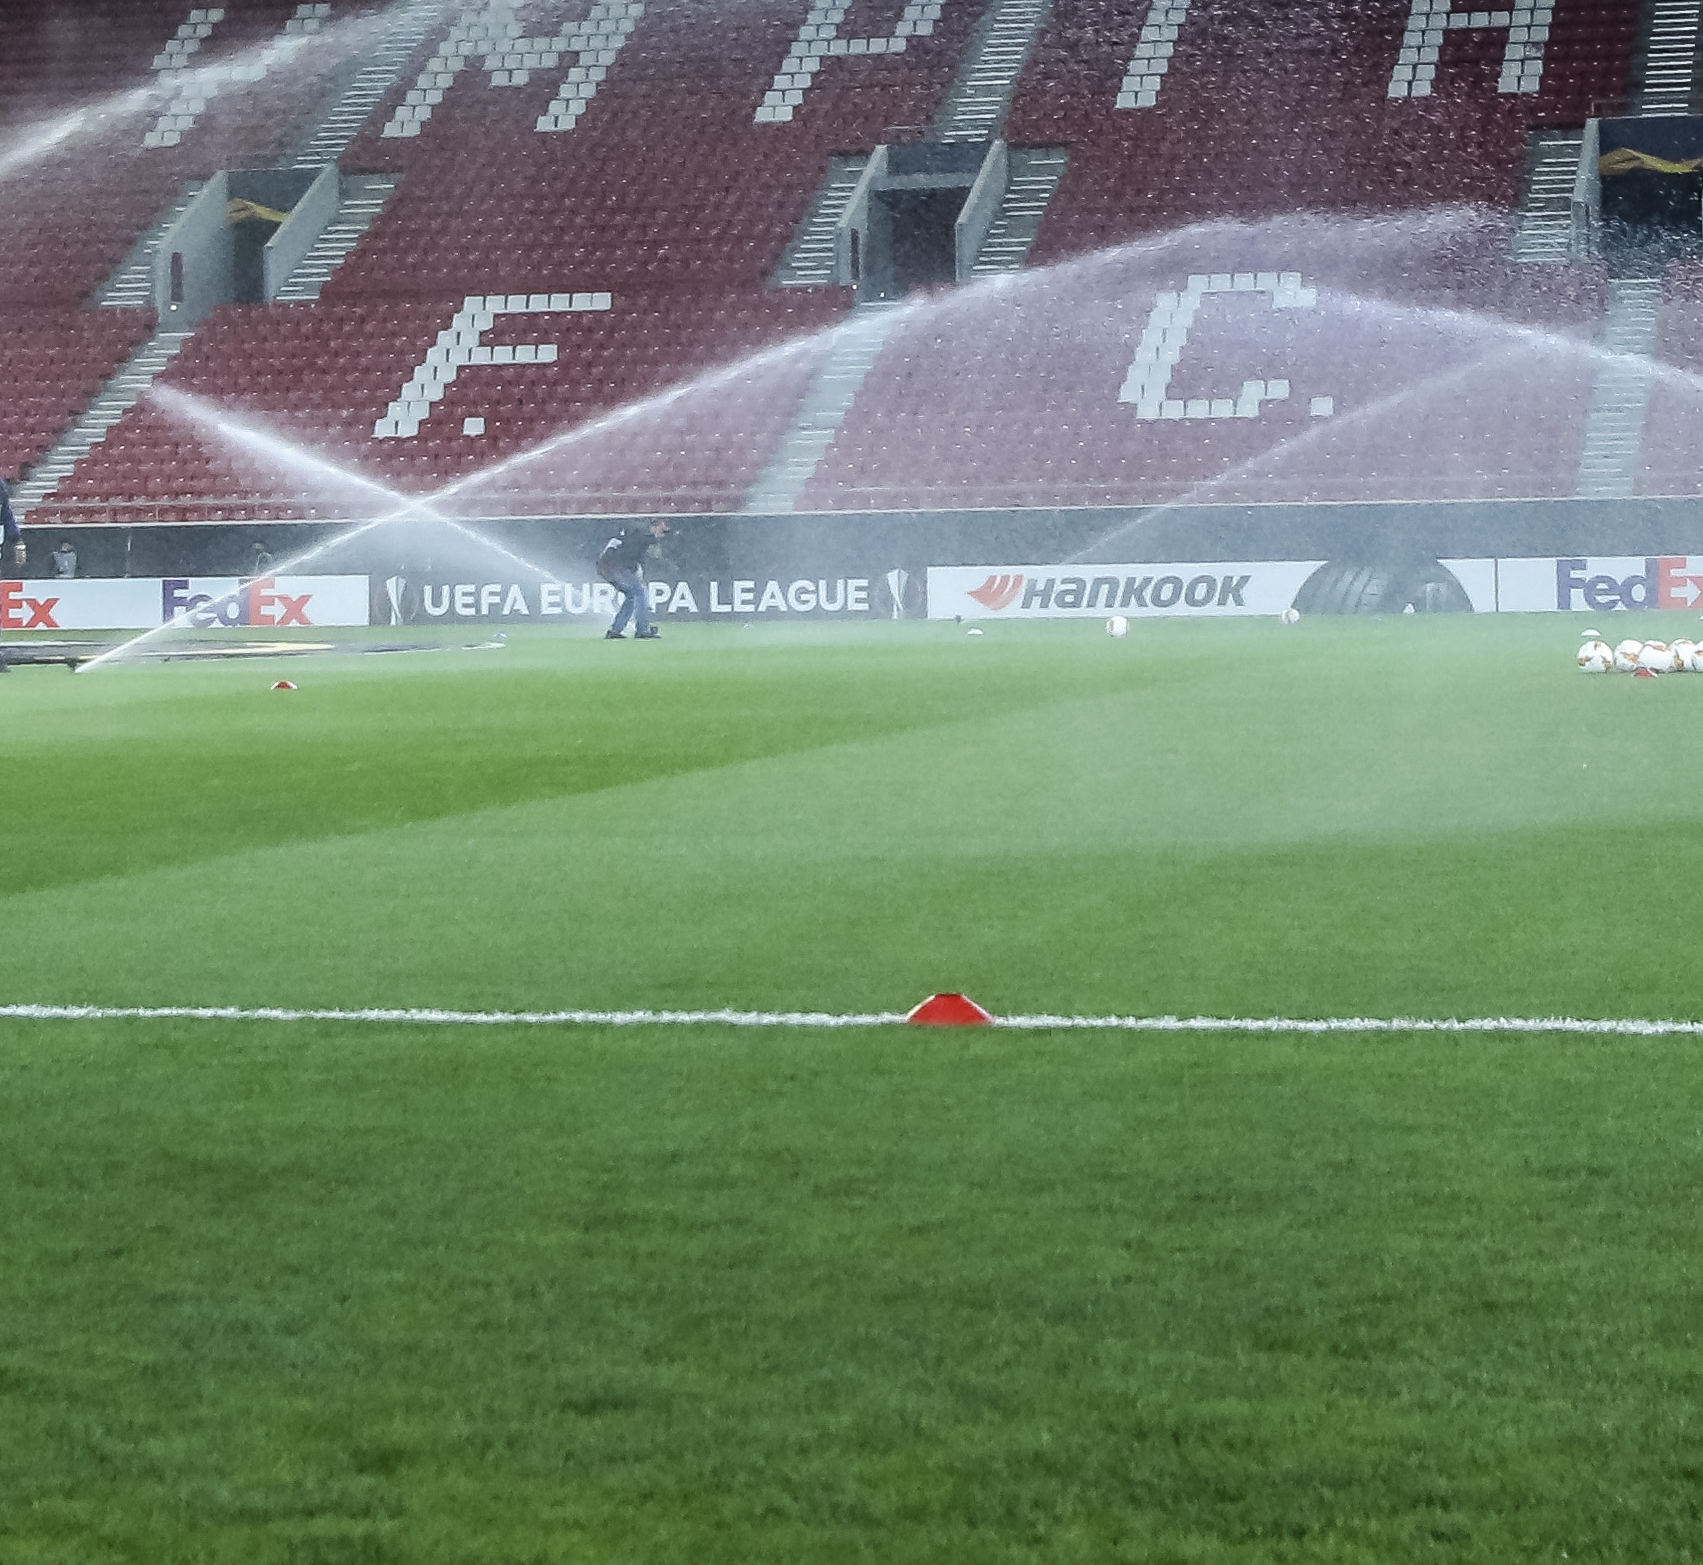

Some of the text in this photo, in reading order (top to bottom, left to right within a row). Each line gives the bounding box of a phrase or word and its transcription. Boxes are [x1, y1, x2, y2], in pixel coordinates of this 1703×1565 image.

[162, 578, 314, 627] FedEx
[423, 578, 870, 616] UEFA EURPA LEAGUE
